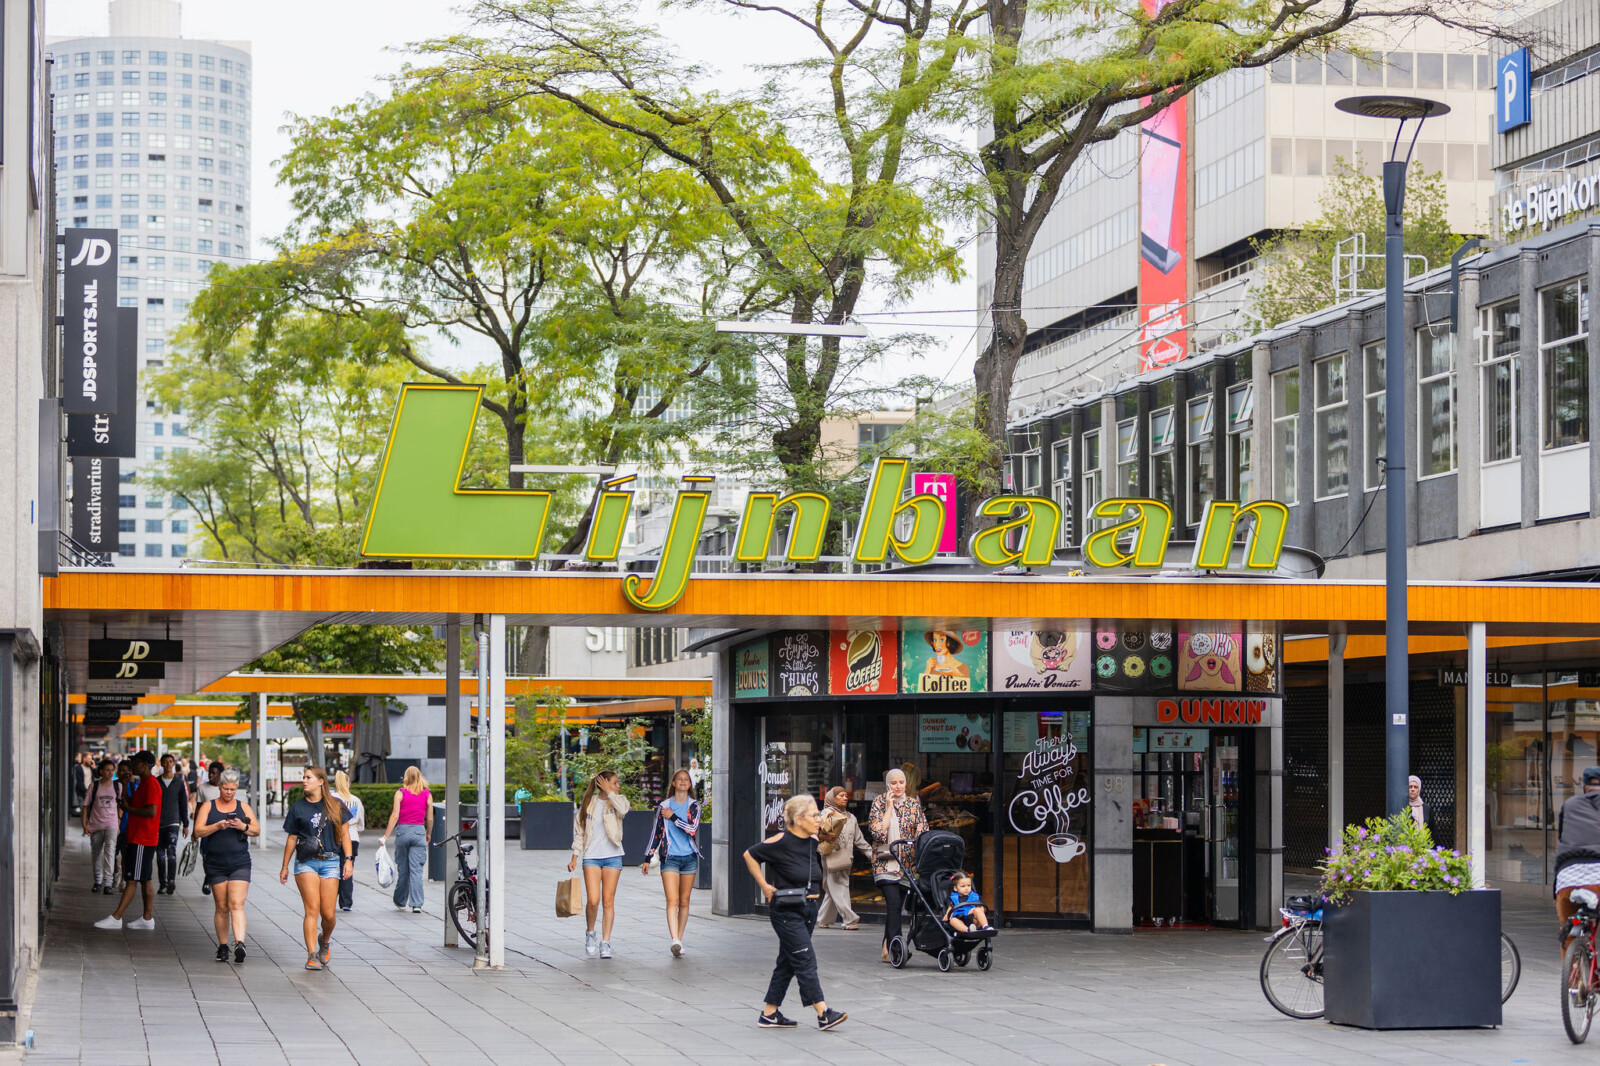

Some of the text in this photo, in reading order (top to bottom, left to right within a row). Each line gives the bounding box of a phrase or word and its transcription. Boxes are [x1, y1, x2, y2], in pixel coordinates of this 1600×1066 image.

[1504, 70, 1517, 123] P
[1503, 167, 1600, 232] de Bijenkor
[71, 238, 112, 266] JD
[83, 279, 98, 402] JDSPORTS.NL
[87, 458, 102, 544] stradivarius
[359, 382, 1291, 611] Lijnbaan
[122, 641, 150, 660] JD
[116, 662, 138, 679] JD
[738, 670, 767, 690] DONUTS
[848, 661, 881, 690] COFFEE
[1005, 673, 1081, 689] Dunkin' Donuts
[1444, 671, 1509, 685] MAELD
[780, 672, 819, 693] THINGS
[923, 675, 967, 692] Coffee
[1157, 699, 1266, 725] DUNKIN'
[1035, 732, 1073, 755] There's
[1017, 742, 1077, 779] Always
[758, 761, 788, 784] Donuts
[1030, 766, 1074, 789] TIME FOR
[1104, 776, 1124, 793] 98
[1008, 784, 1091, 834] Coffee
